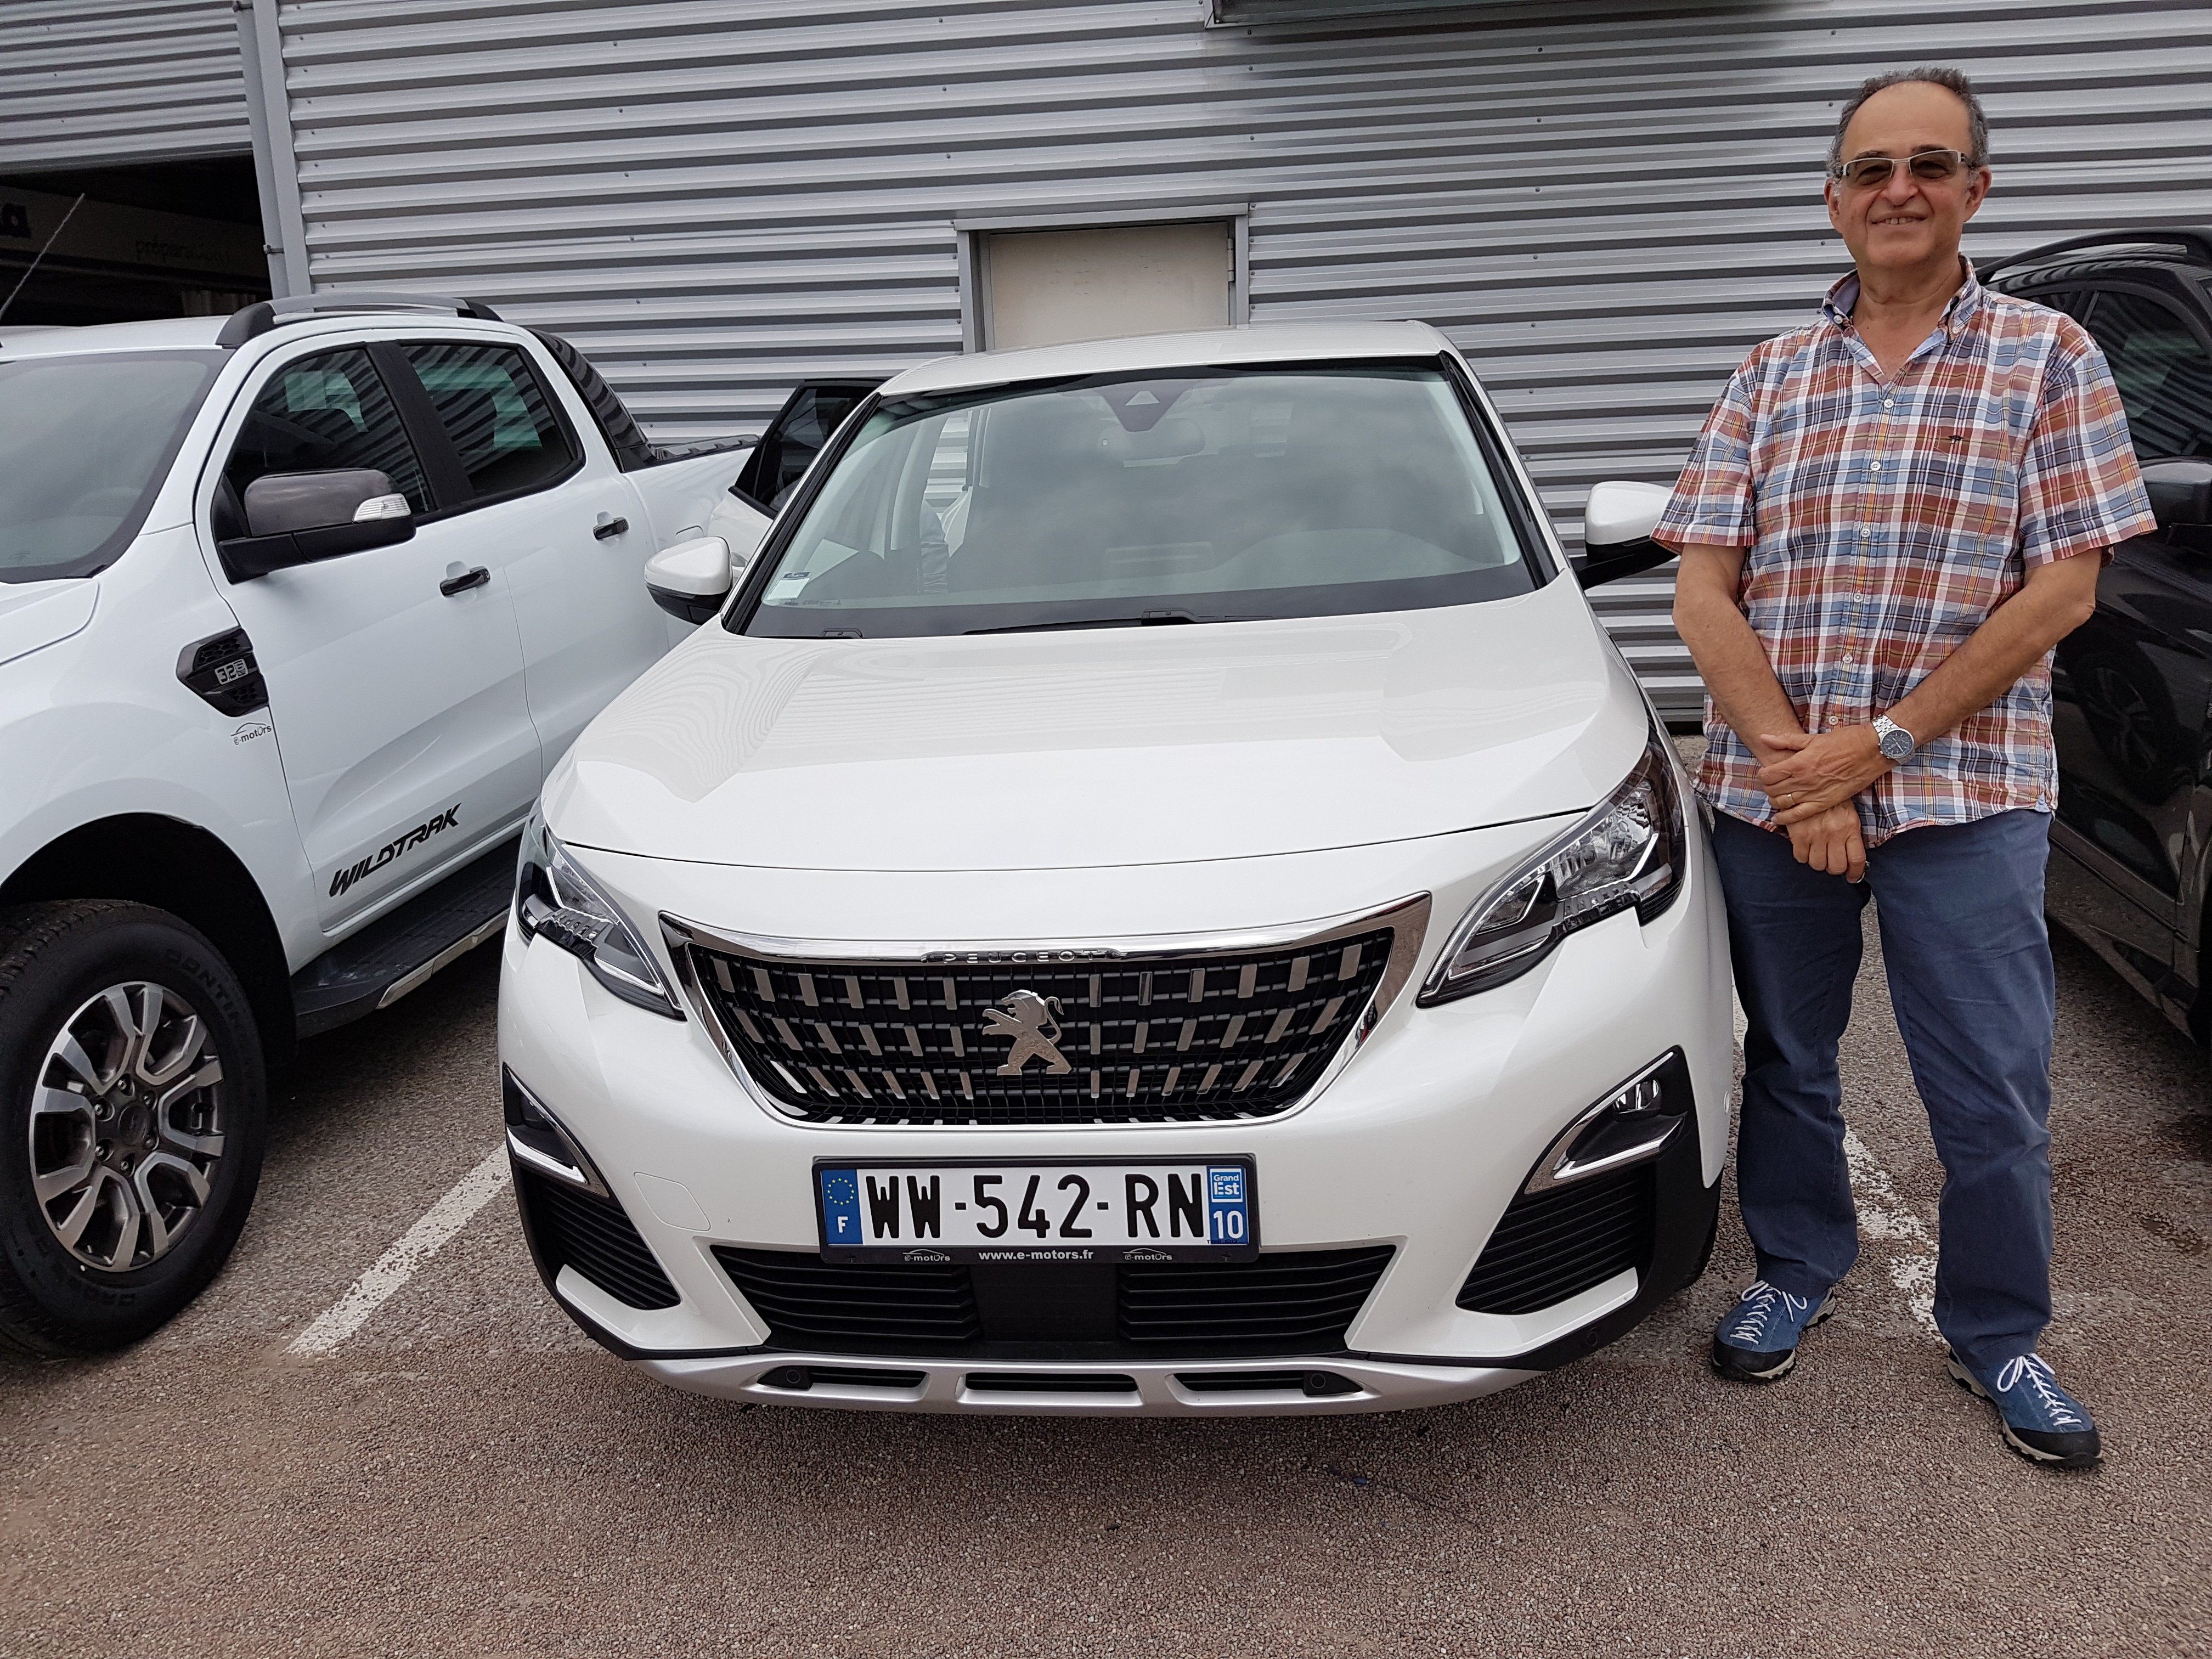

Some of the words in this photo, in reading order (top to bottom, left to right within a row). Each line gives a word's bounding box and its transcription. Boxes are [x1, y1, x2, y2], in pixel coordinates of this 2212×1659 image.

[329, 802, 461, 897] WILDTRAK
[943, 949, 1098, 964] PEUGEOT
[1214, 1182, 1240, 1195] Est
[837, 1216, 849, 1233] F
[1213, 1210, 1244, 1239] 10
[978, 1249, 1094, 1262] www.e-motors.fr
